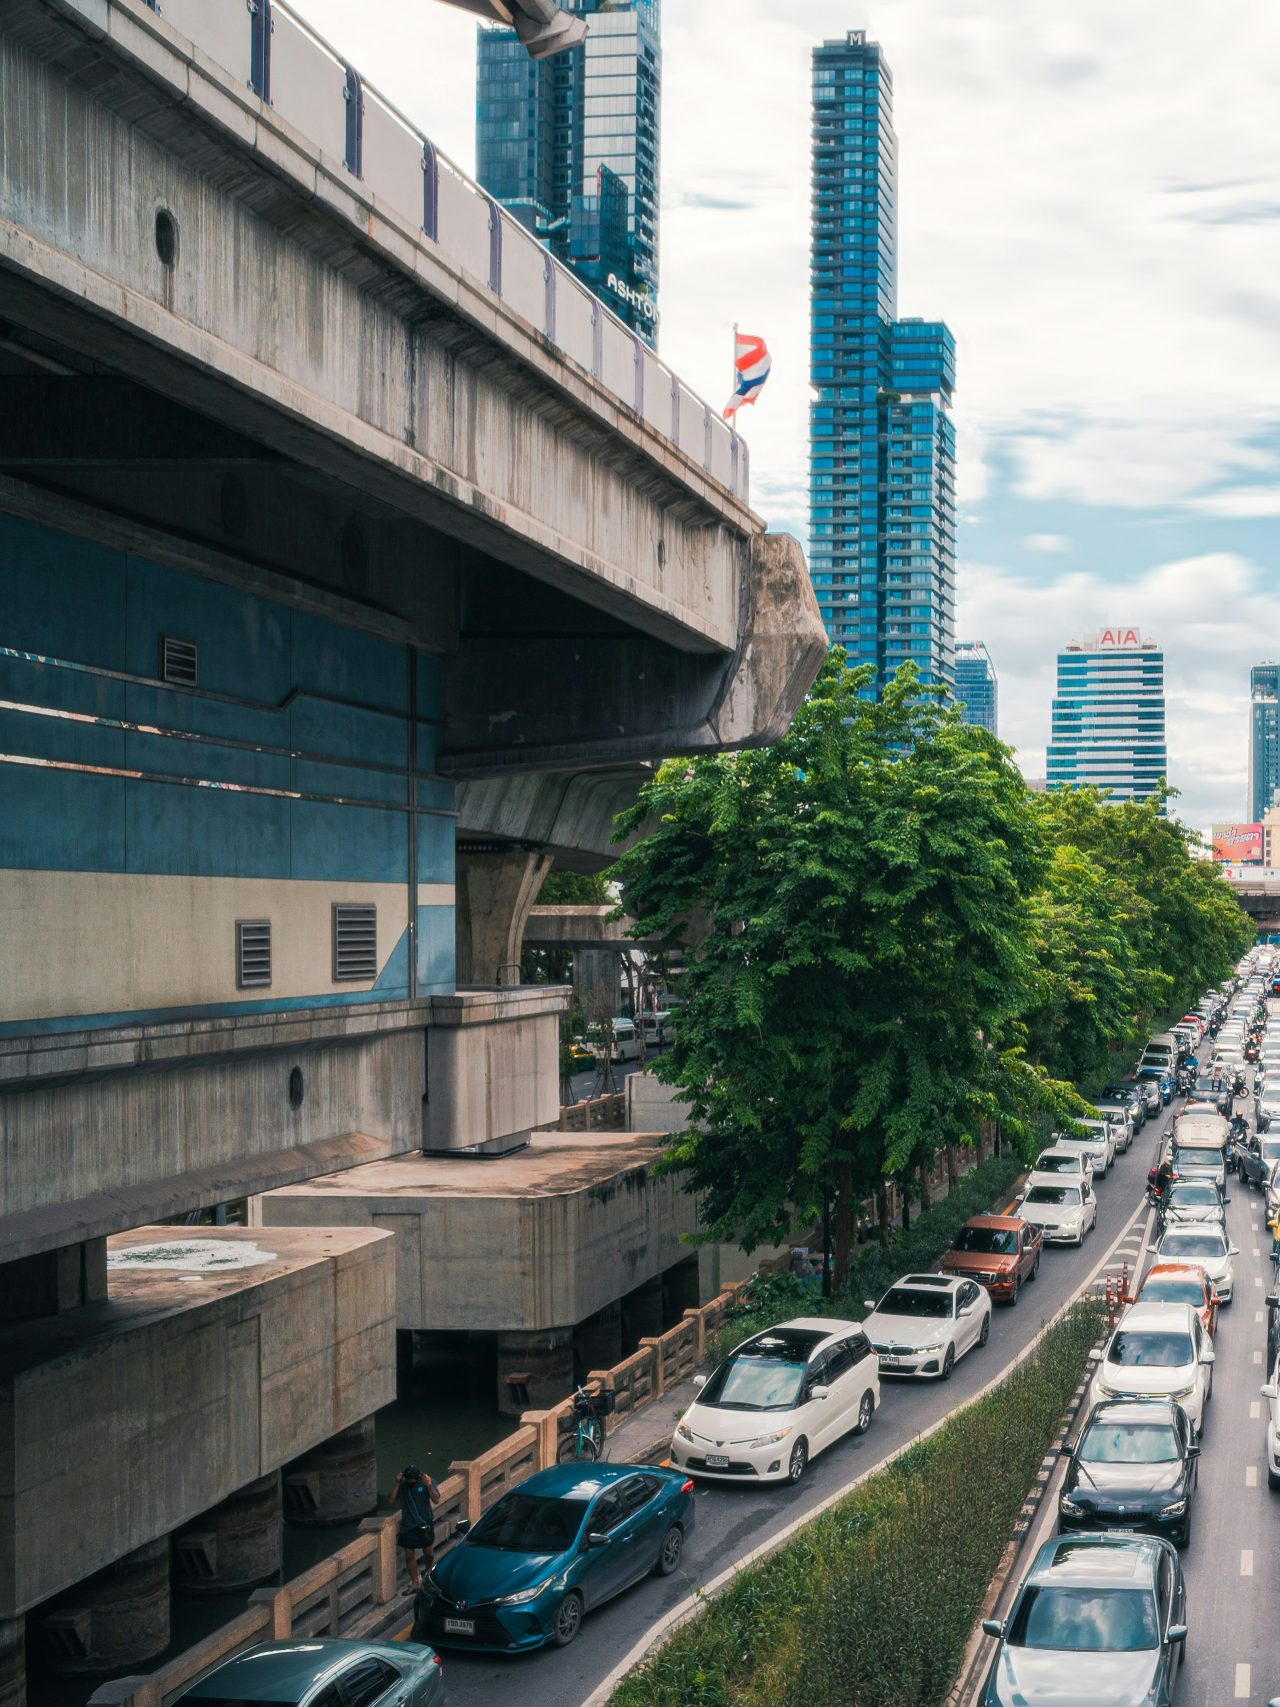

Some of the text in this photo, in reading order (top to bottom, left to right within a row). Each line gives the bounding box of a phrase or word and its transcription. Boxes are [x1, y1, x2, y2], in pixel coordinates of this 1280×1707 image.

[850, 32, 862, 46] M
[607, 273, 660, 322] ASHTON
[1101, 630, 1138, 645] AIA
